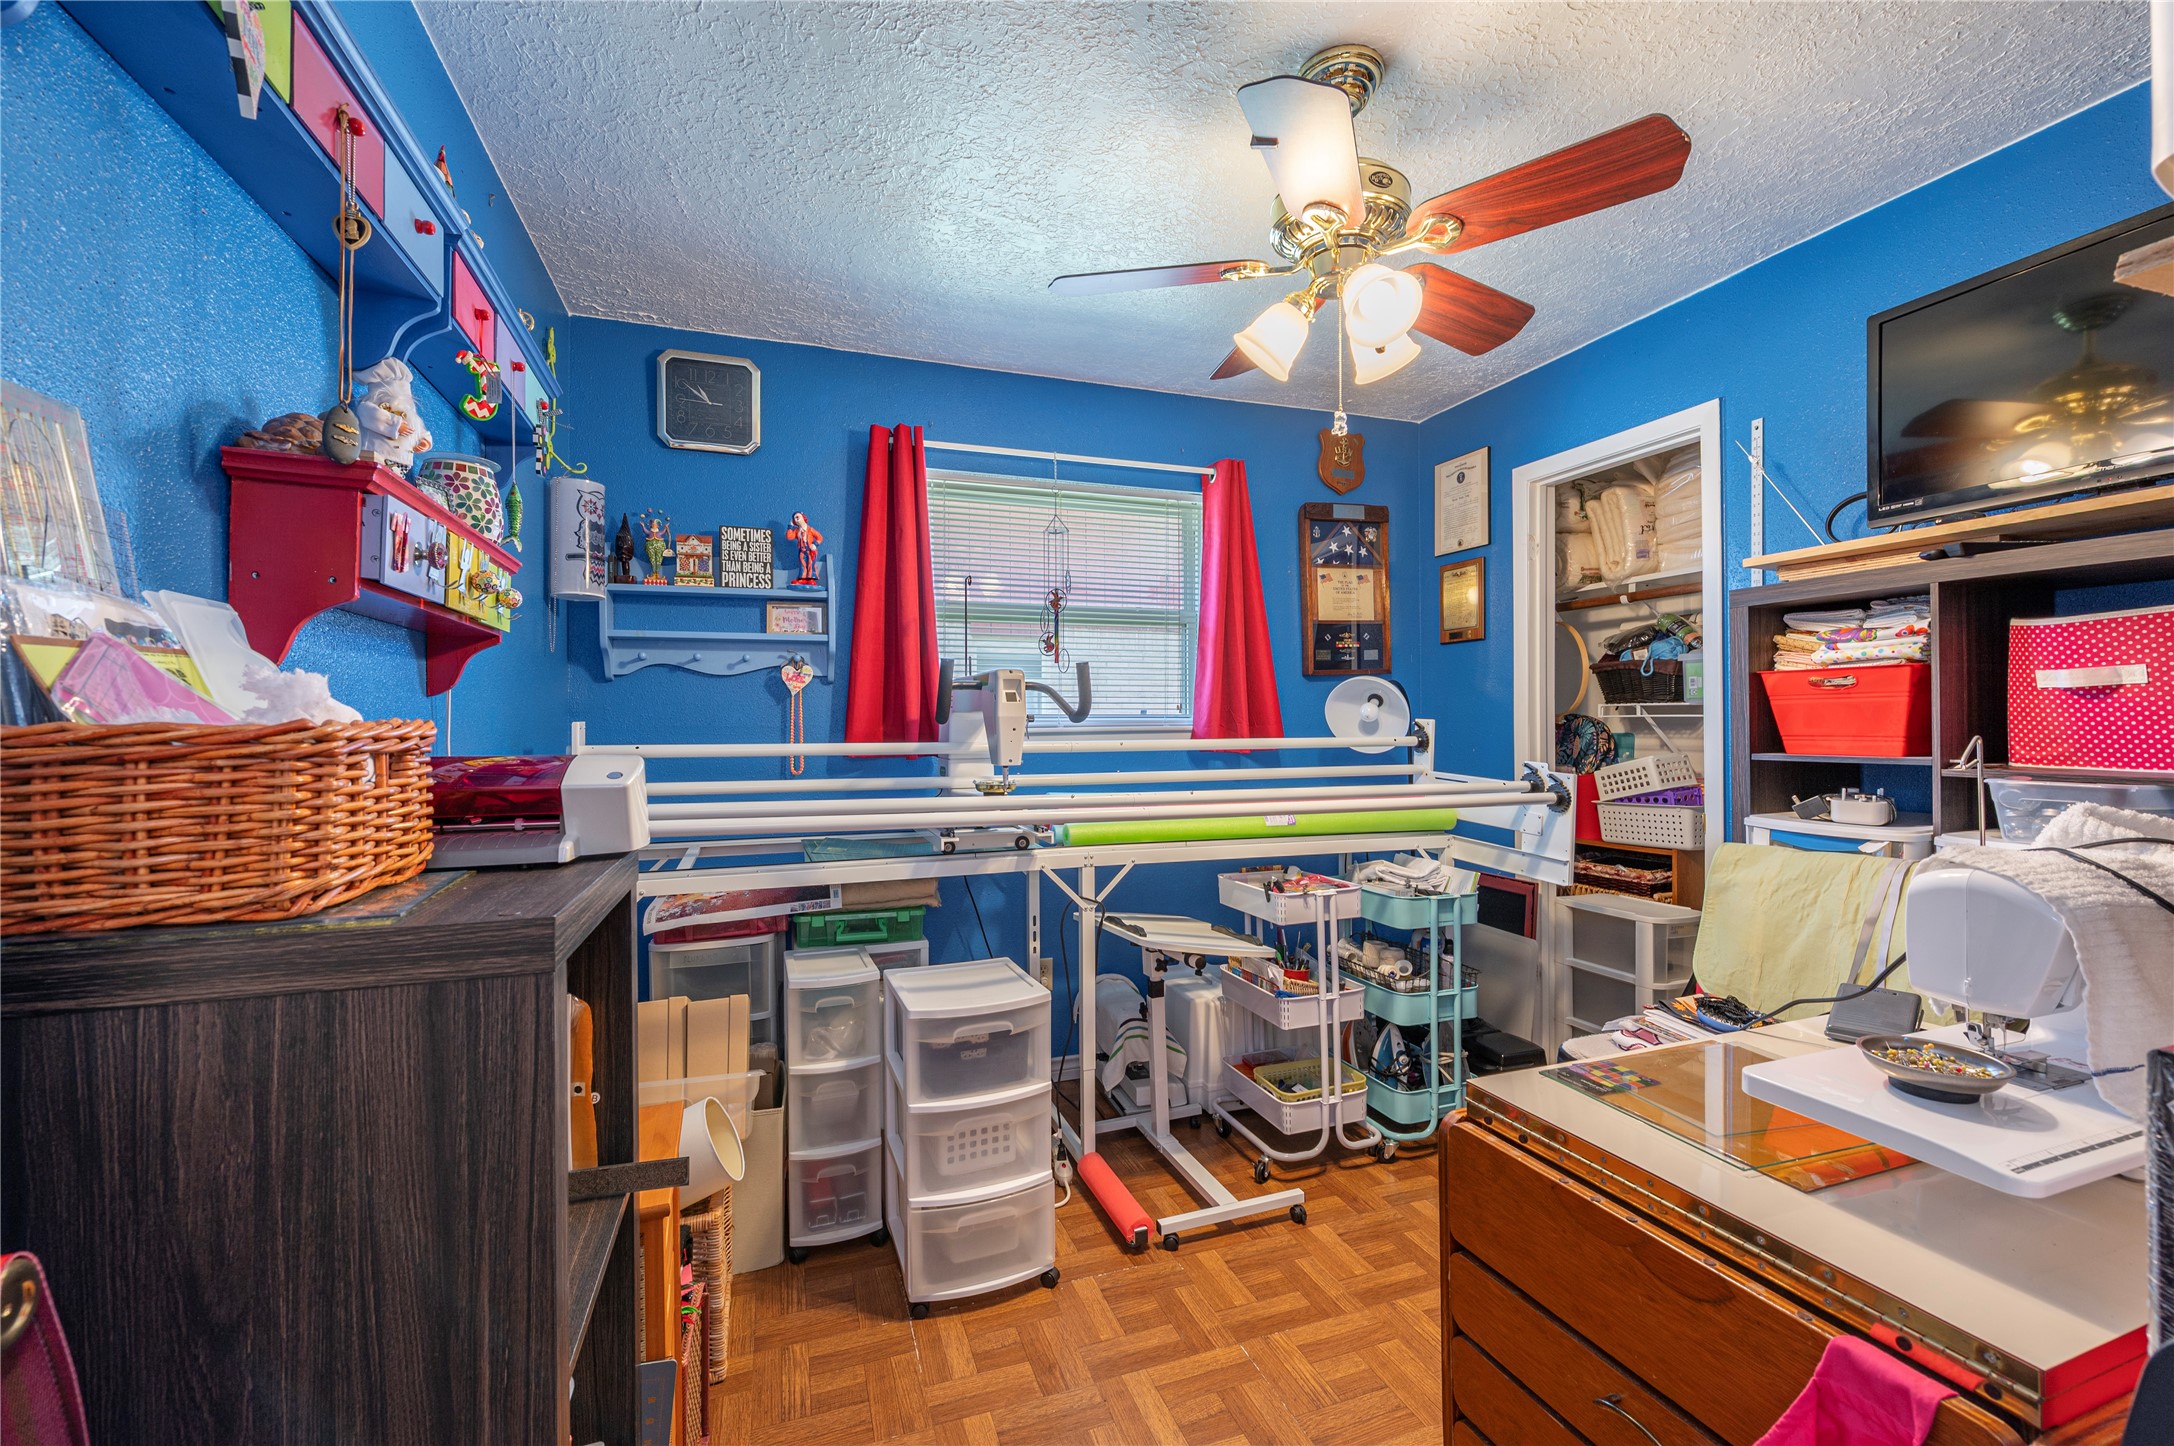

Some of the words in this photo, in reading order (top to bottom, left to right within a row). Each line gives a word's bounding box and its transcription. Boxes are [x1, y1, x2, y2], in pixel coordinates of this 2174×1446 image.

[674, 376, 688, 390] 10
[704, 369, 716, 384] 12
[734, 384, 743, 397] 2
[734, 400, 744, 413] 3
[676, 410, 686, 424] 8
[734, 417, 743, 429] 4
[705, 424, 715, 438] 6
[722, 425, 732, 440] 5
[721, 526, 772, 543] SOMETIMES
[721, 540, 742, 550] BEING
[742, 541, 748, 551] A
[749, 542, 772, 552] SISTER
[721, 550, 729, 560] IS
[730, 551, 747, 561] EVEN
[748, 552, 772, 562] BETTER
[721, 561, 741, 572] THAN
[742, 562, 764, 573] BEING
[765, 563, 772, 573] A
[721, 572, 772, 589] PRINCESS
